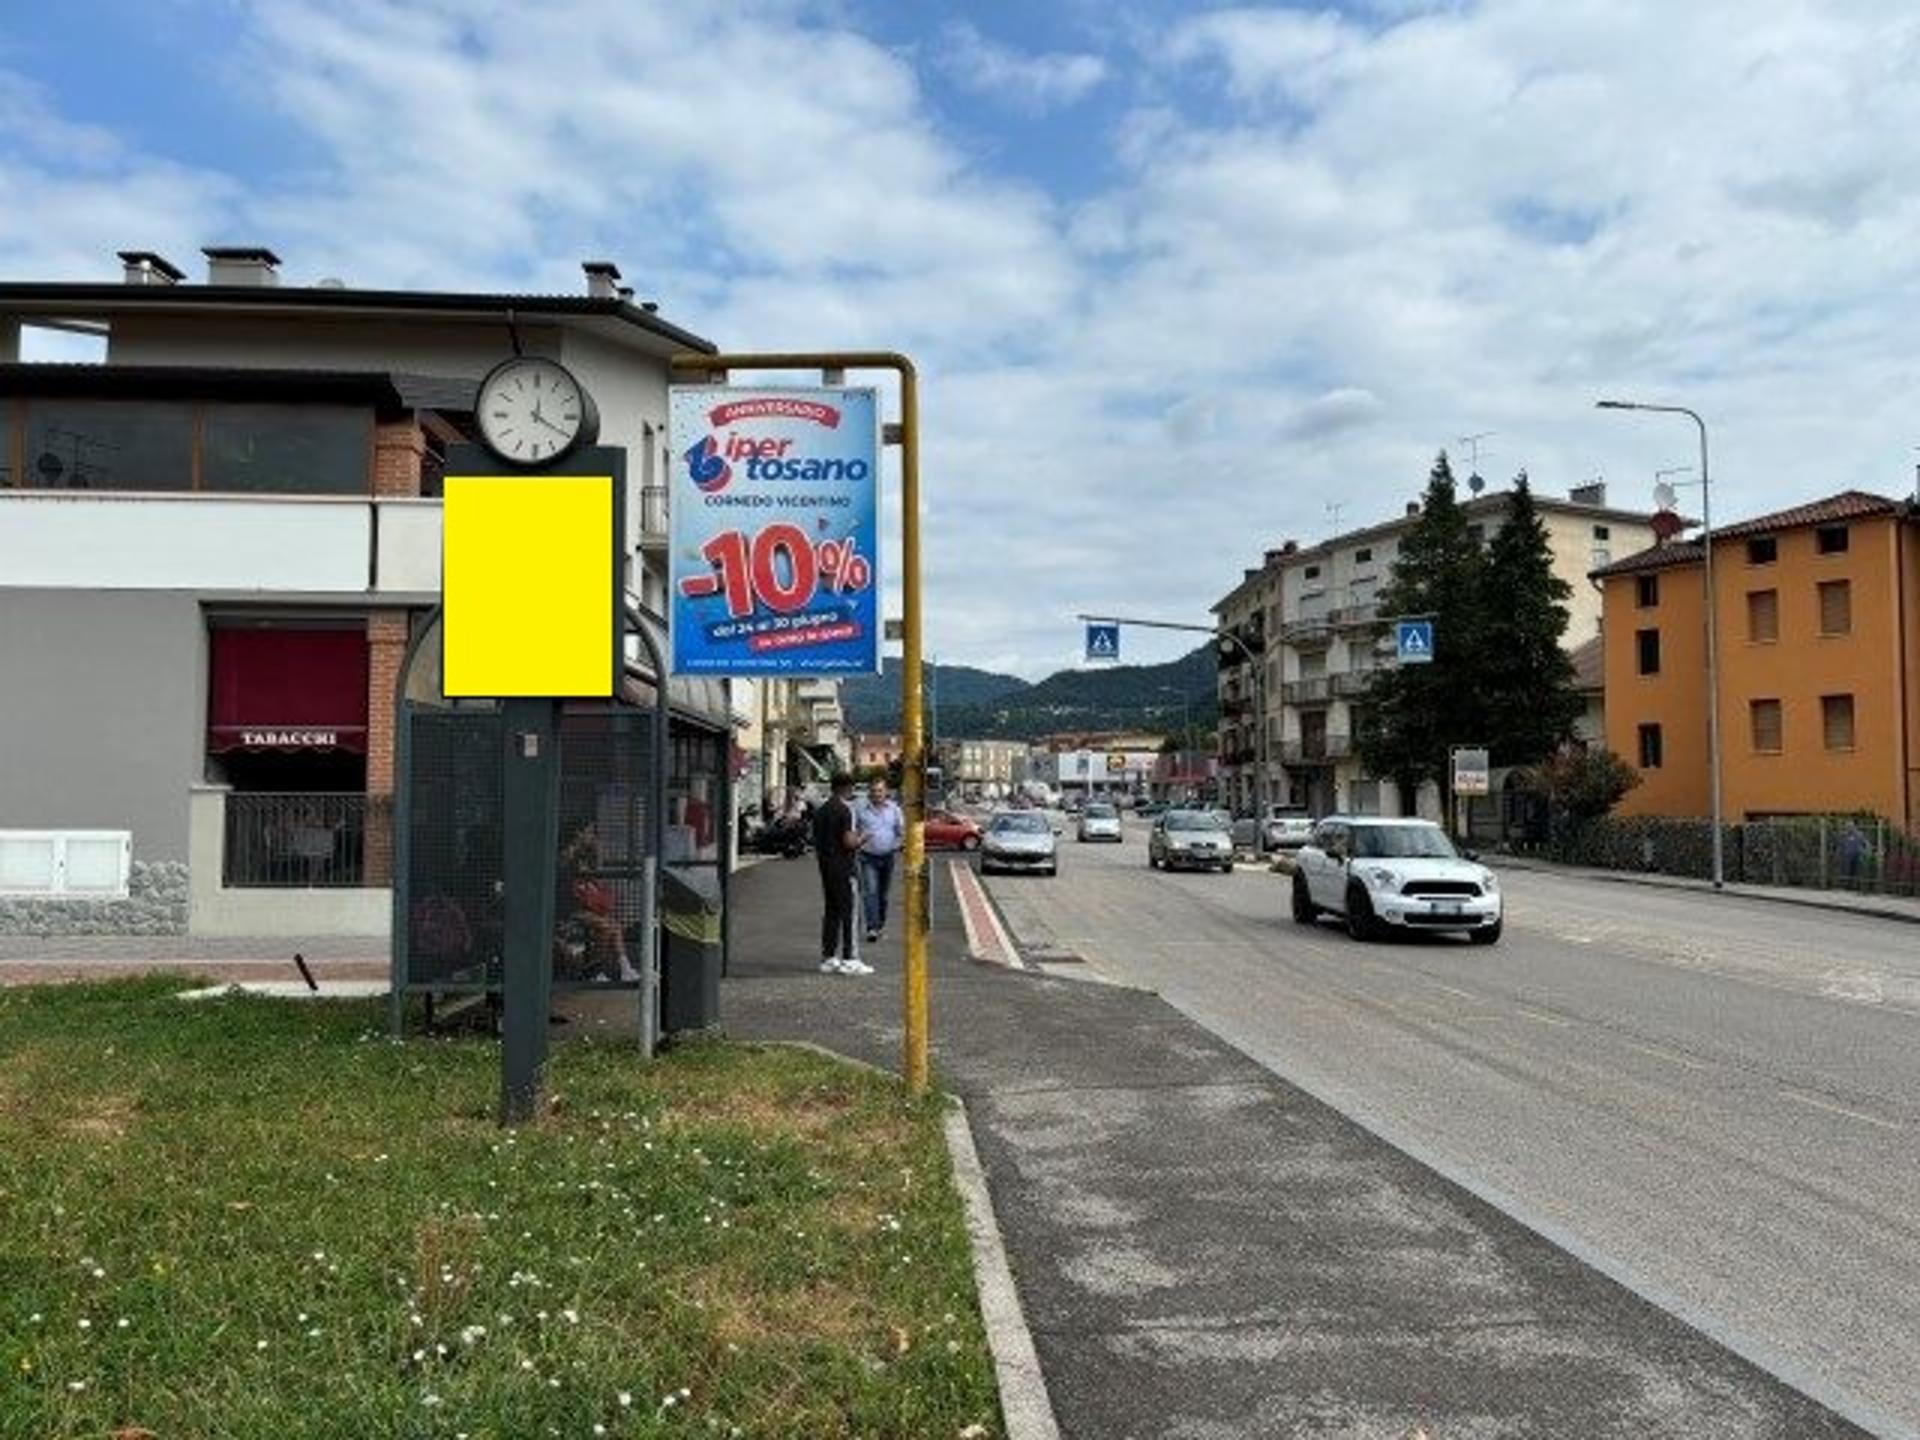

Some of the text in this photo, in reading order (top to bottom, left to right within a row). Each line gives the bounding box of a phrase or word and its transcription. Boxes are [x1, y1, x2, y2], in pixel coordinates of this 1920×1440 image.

[725, 431, 792, 462] iper
[746, 457, 868, 481] tosano
[704, 494, 851, 508] CORNEDO VICENTINO
[679, 521, 871, 618] -10%
[773, 616, 790, 629] 30
[242, 732, 337, 745] TABACCHI
